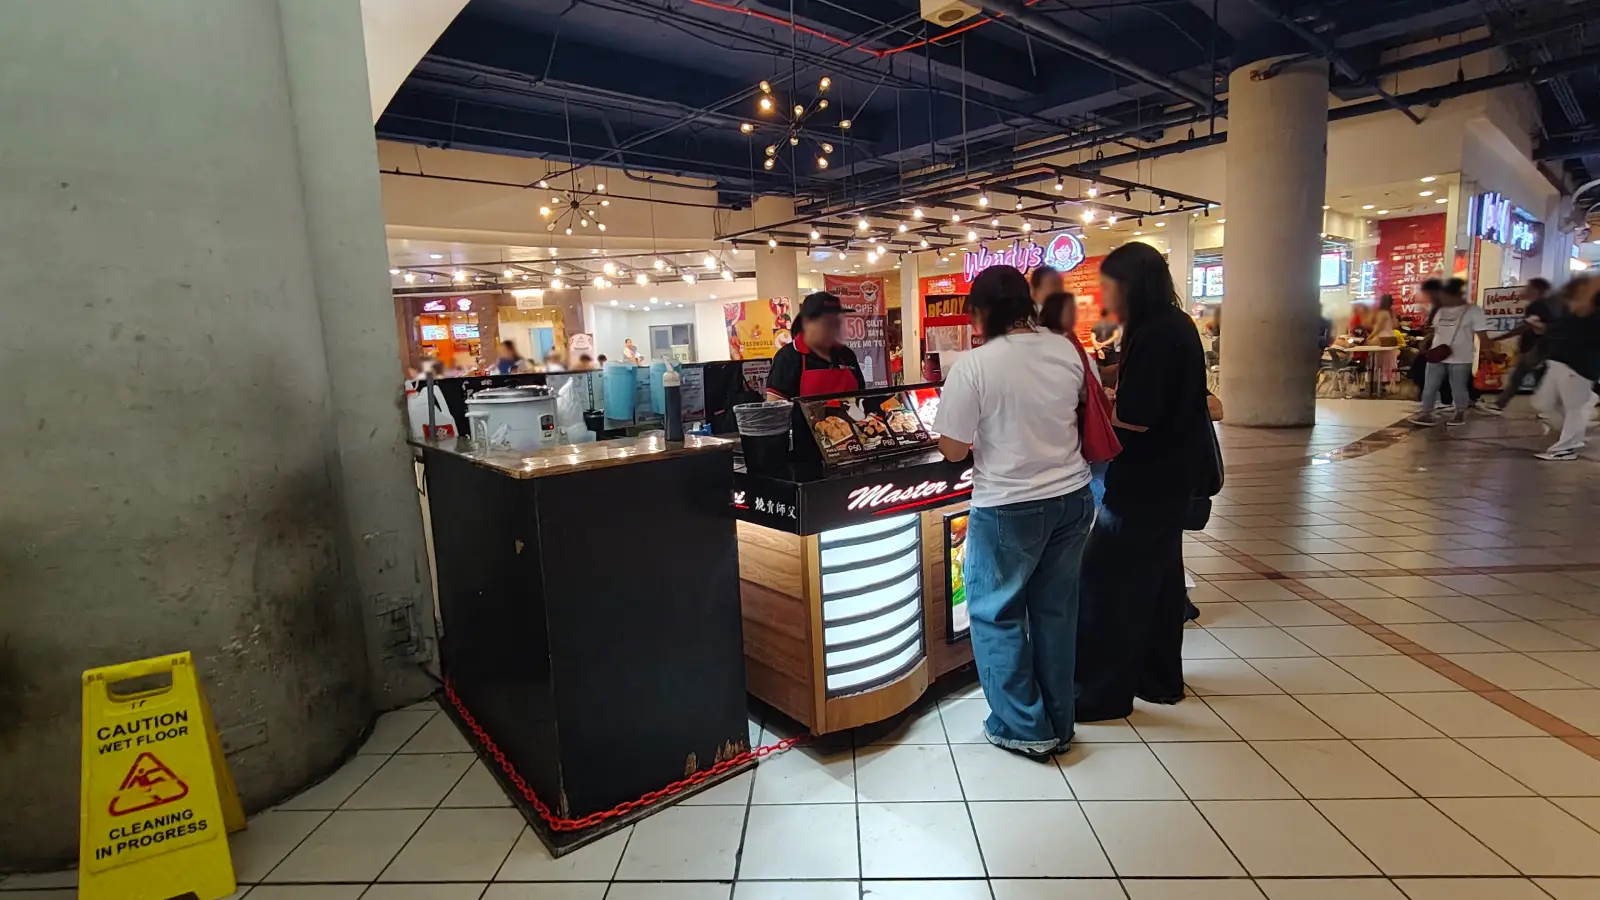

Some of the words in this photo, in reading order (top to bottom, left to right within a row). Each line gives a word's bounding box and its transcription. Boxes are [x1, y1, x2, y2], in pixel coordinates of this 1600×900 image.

[963, 238, 1044, 283] Wendy's
[854, 303, 879, 313] OPEN
[1486, 290, 1522, 305] Wendy
[848, 444, 862, 453] P50
[847, 480, 948, 511] Master
[953, 467, 973, 491] S
[96, 709, 189, 741] CAUTION
[97, 738, 133, 755] WET
[136, 725, 189, 747] FLOOR
[95, 844, 113, 861] IN
[116, 819, 208, 855] PROGRESS
[108, 808, 194, 840] CLEANING
